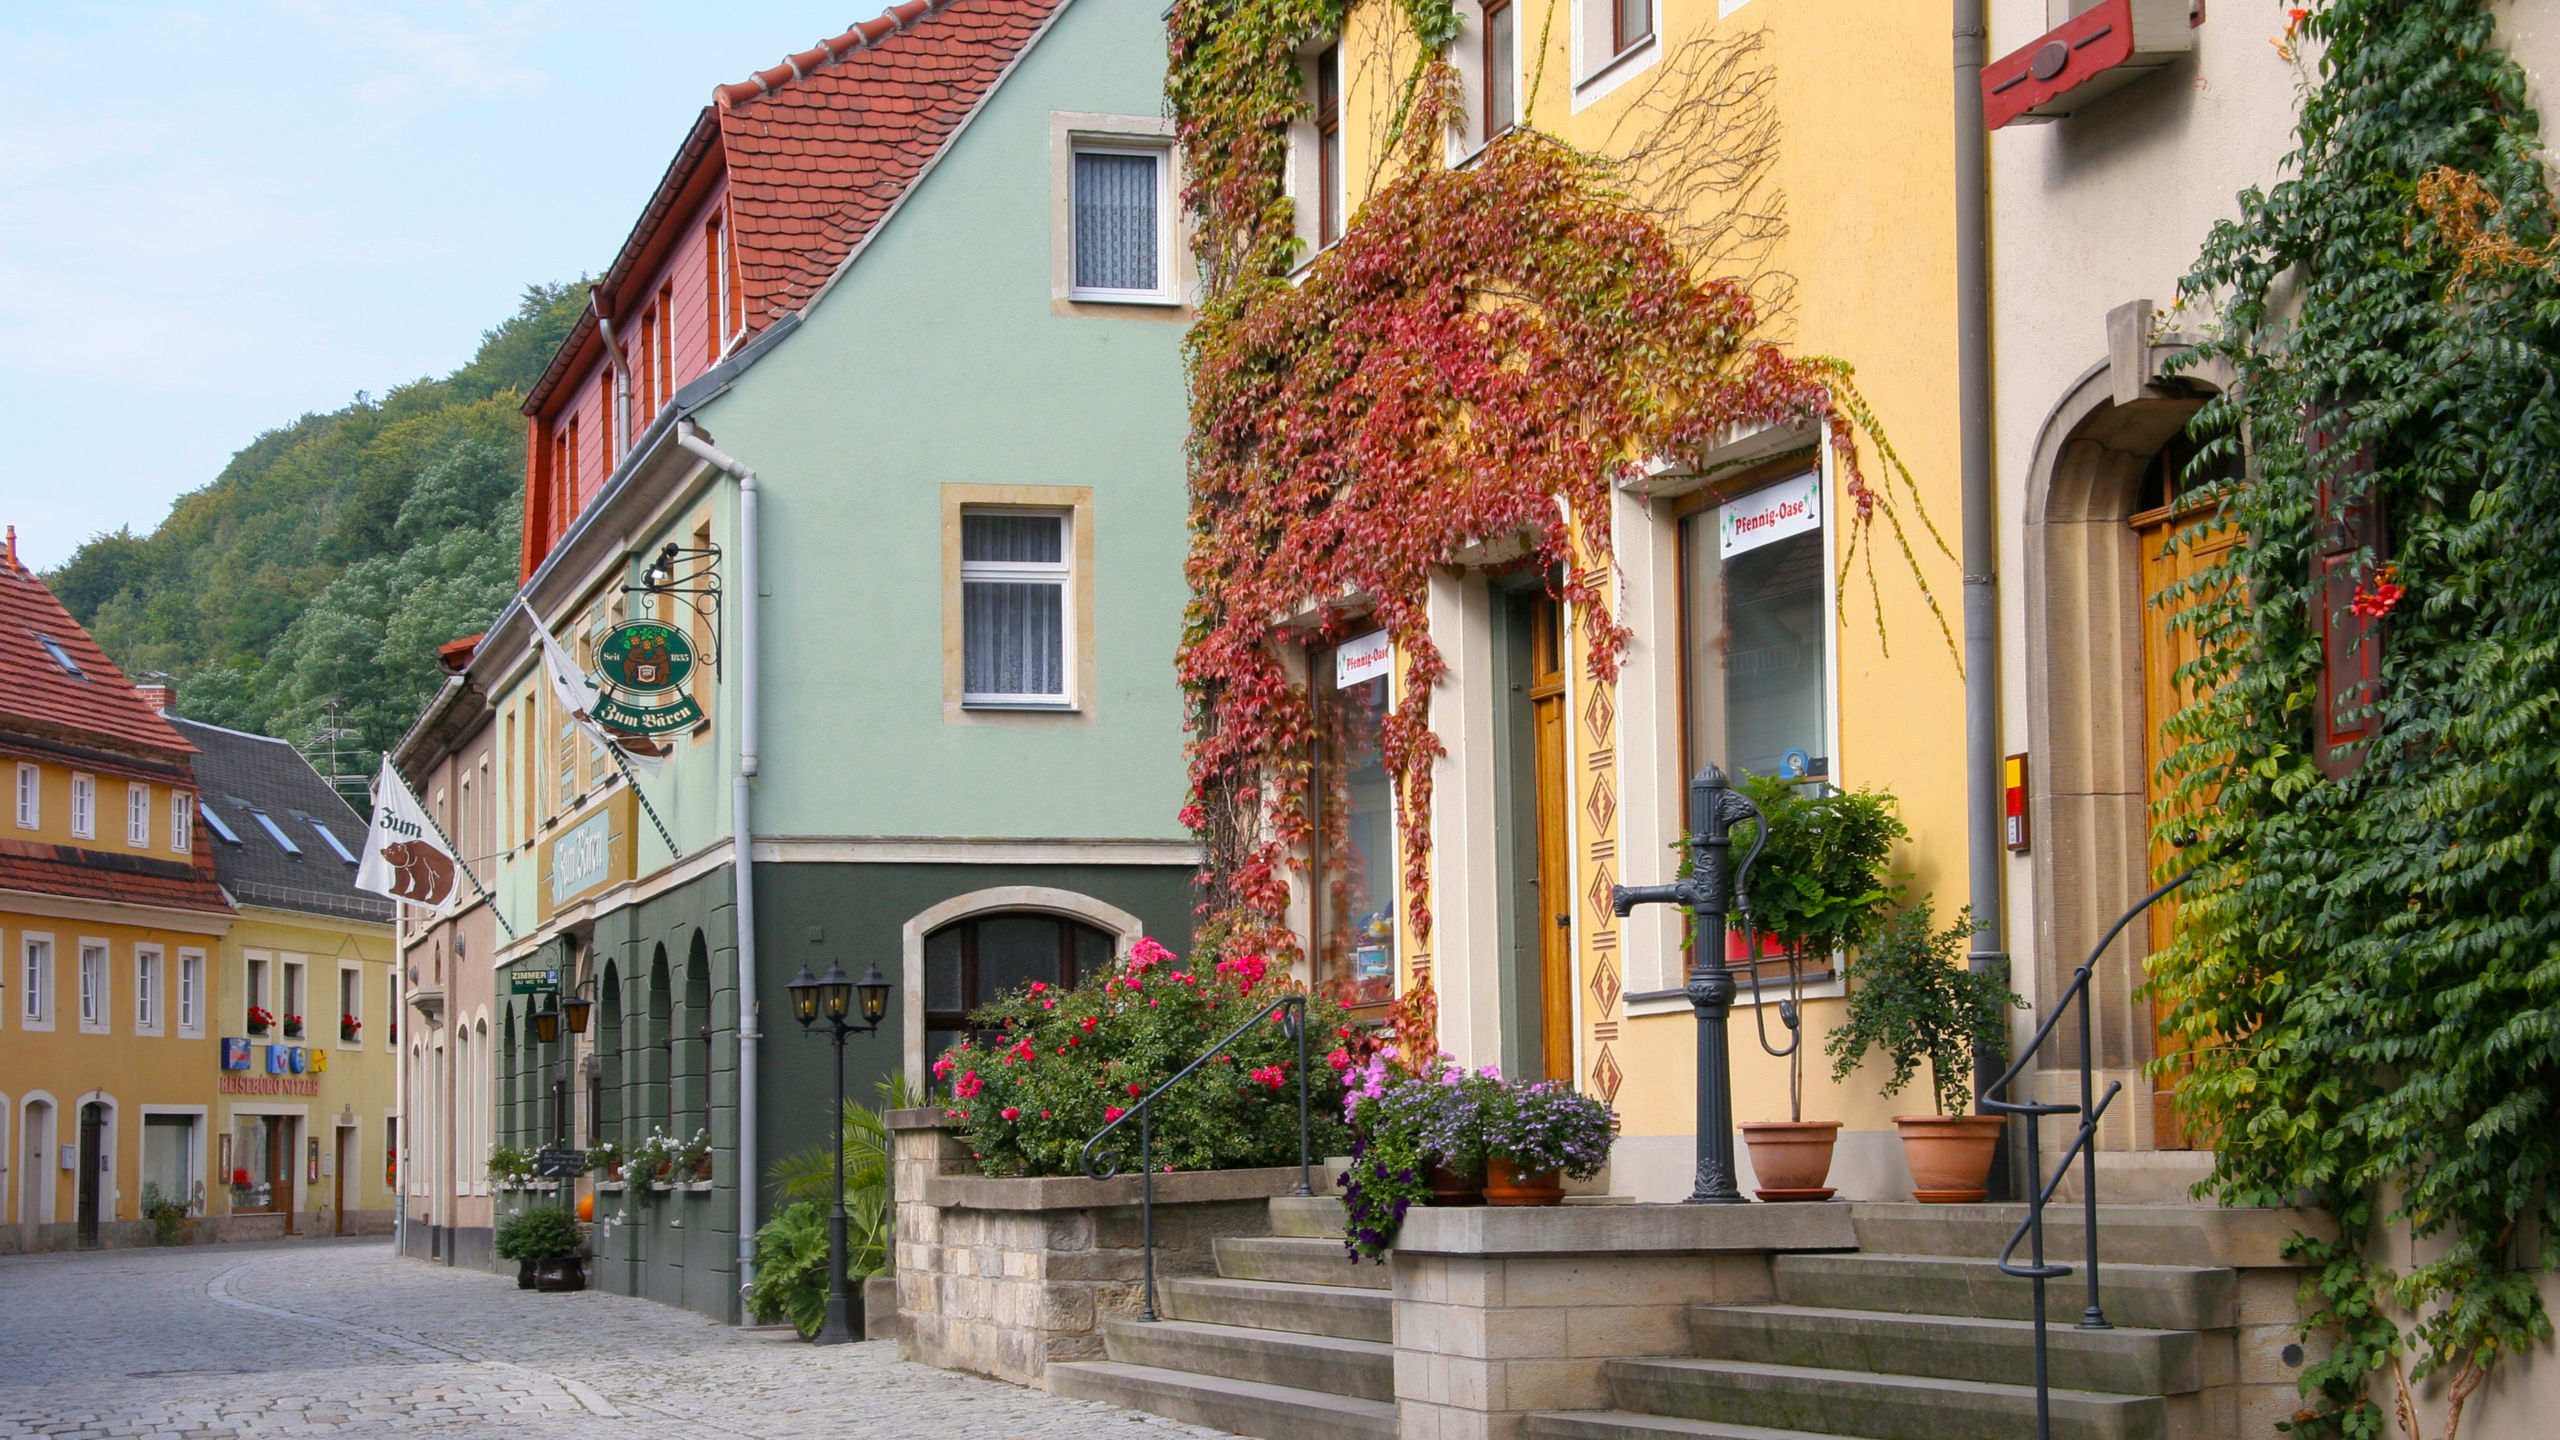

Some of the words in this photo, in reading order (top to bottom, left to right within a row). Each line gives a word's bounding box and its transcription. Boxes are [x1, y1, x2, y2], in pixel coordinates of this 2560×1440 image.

[1735, 500, 1804, 535] Pfennig-Oase
[603, 652, 621, 661] Seit
[601, 703, 638, 728] Zum
[641, 705, 692, 729] Bären
[379, 806, 423, 839] Zum
[511, 971, 547, 980] ZIMMER
[220, 1074, 282, 1095] REISEBÜRO
